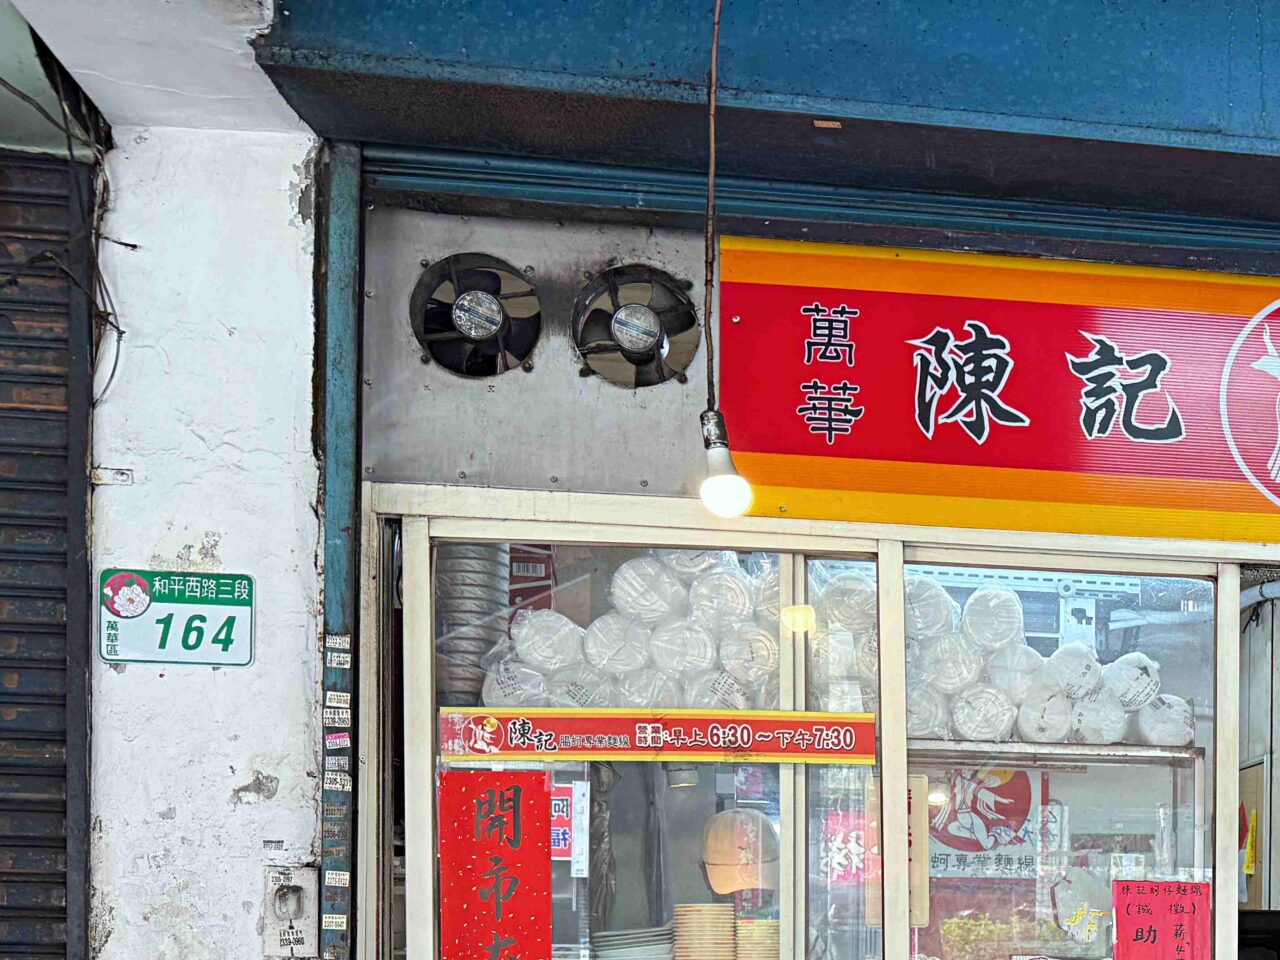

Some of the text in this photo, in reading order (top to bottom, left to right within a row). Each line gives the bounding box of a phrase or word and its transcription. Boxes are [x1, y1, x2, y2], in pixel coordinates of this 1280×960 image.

[797, 302, 865, 445] 萬華
[904, 320, 1186, 445] 陳記
[152, 576, 250, 600] 和平西路三段
[106, 620, 119, 656] 萬華區
[155, 612, 237, 652] 164
[507, 719, 559, 752] 陳記
